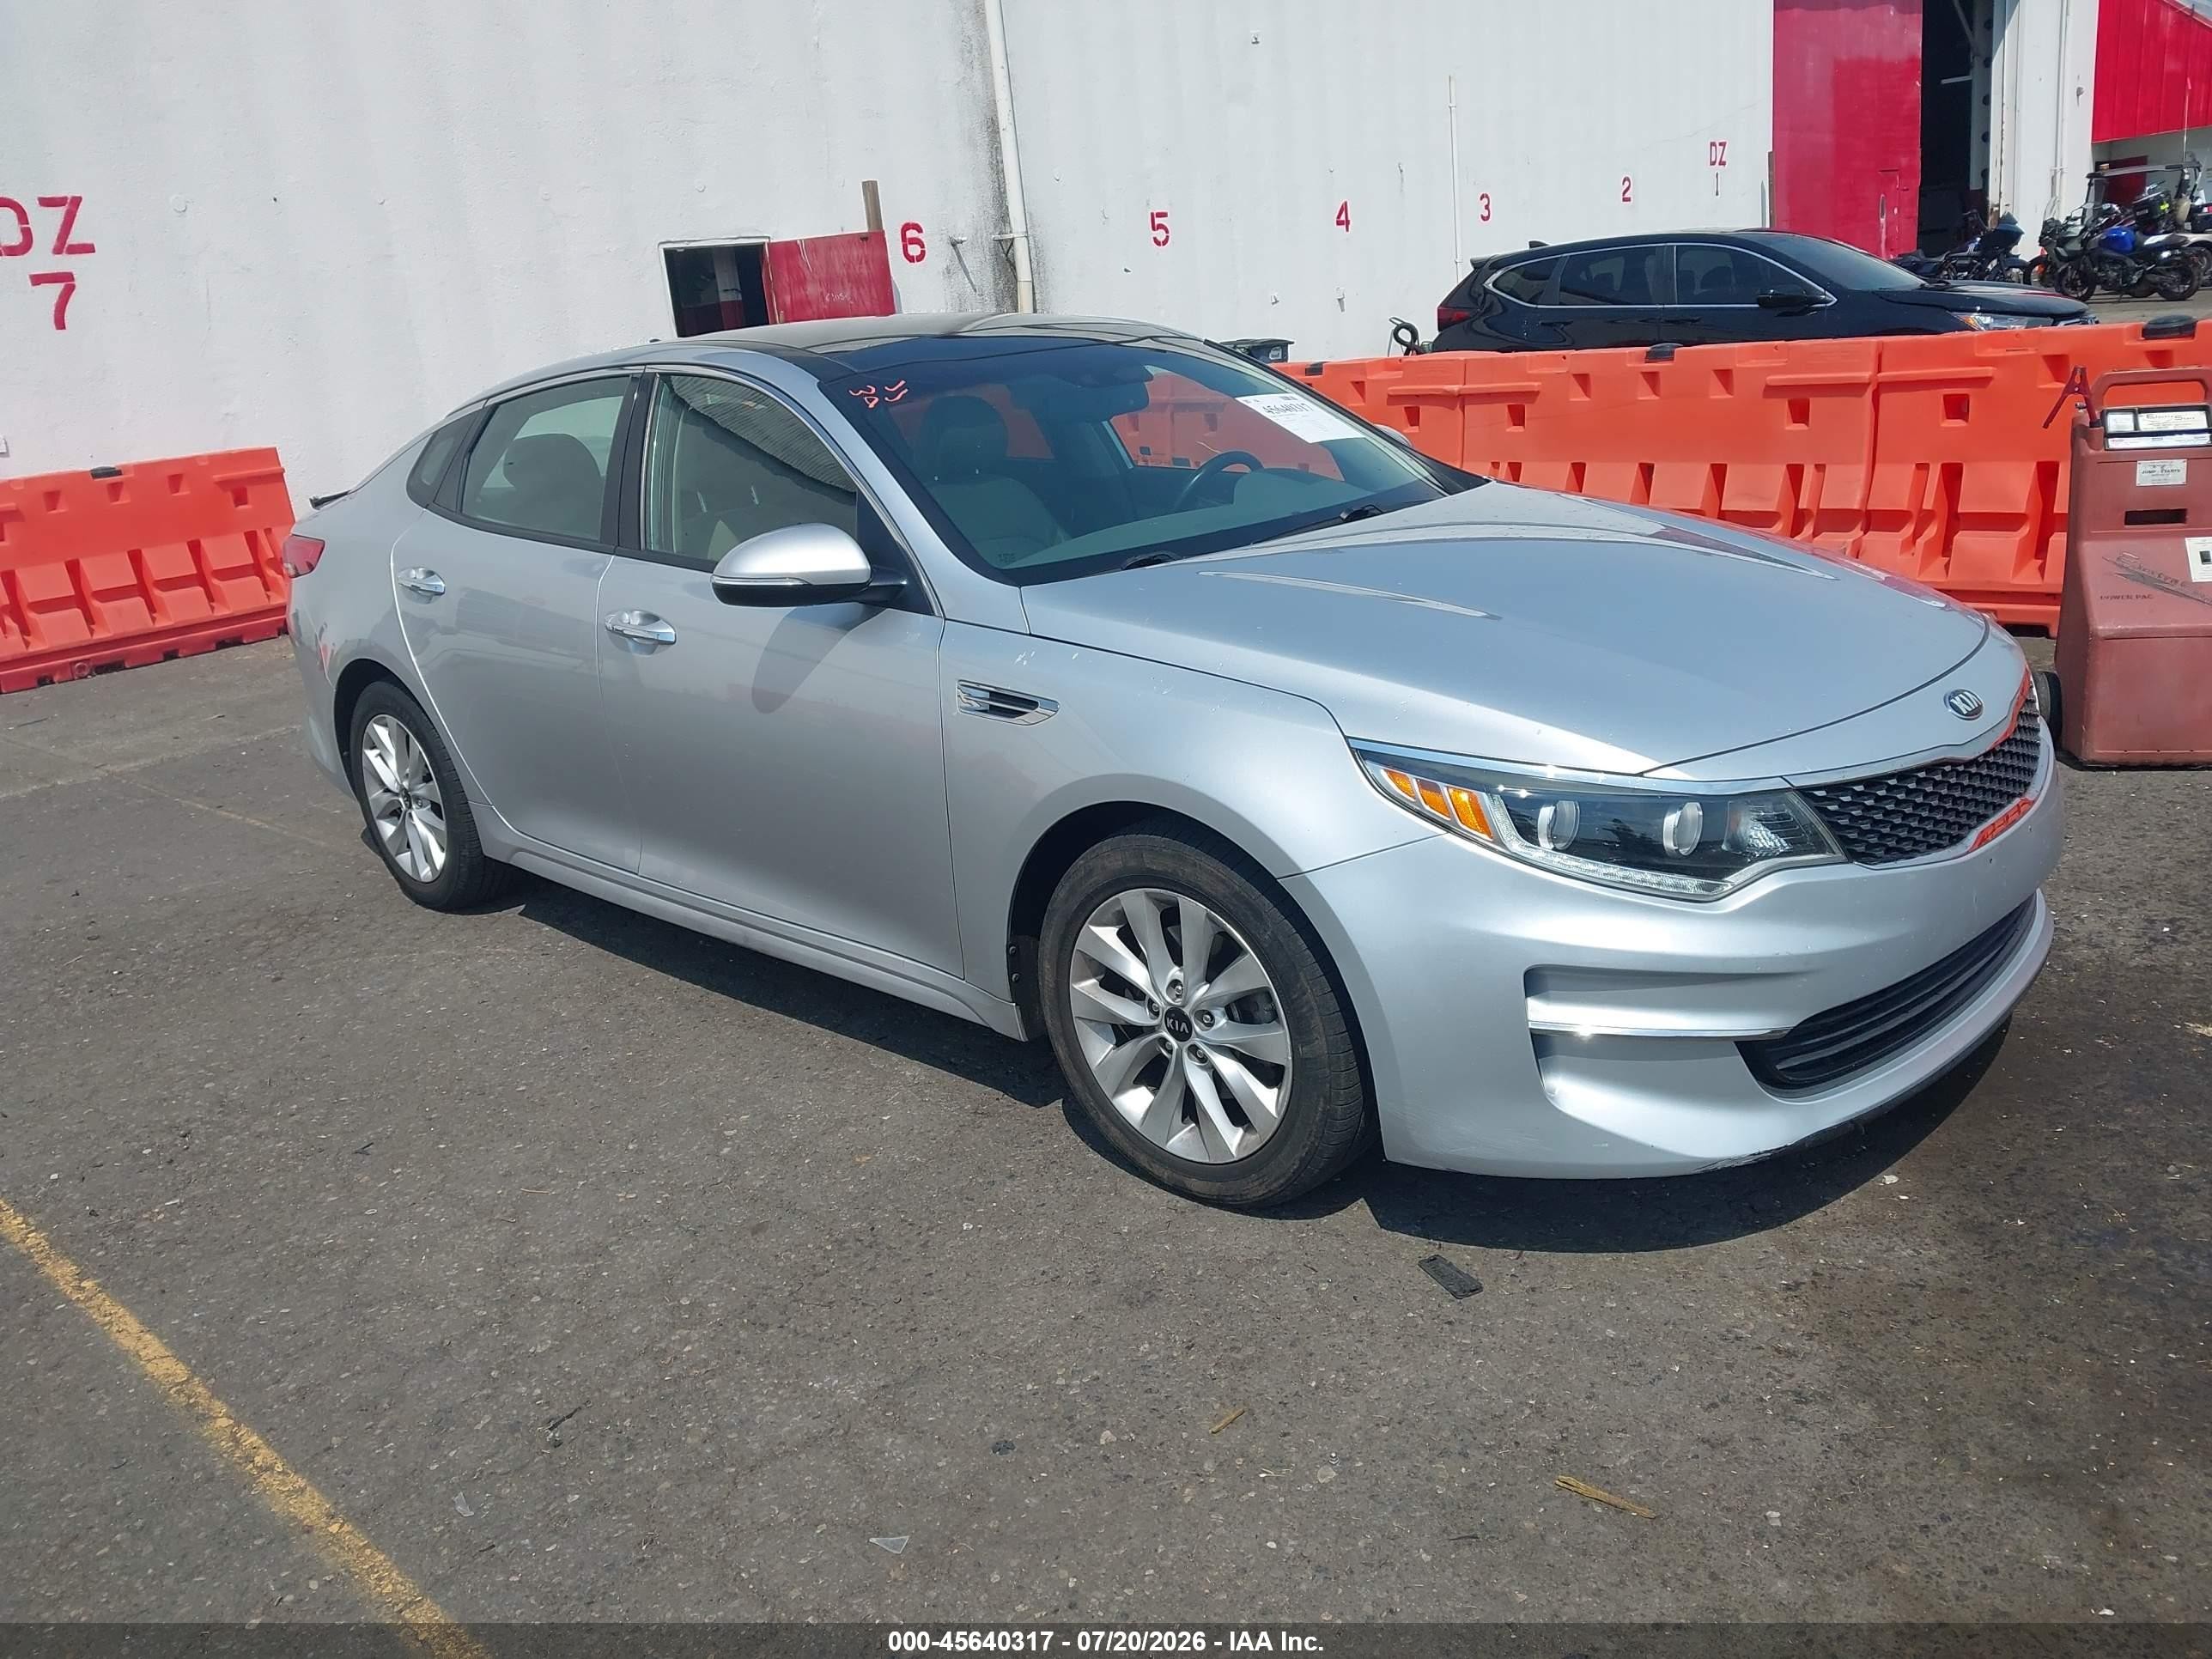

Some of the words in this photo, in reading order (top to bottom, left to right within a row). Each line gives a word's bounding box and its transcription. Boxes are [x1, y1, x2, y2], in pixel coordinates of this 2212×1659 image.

[1710, 141, 1727, 167] DZ
[1621, 176, 1632, 203] 2
[1335, 200, 1351, 233] 4
[1480, 192, 1491, 222] 3
[0, 196, 96, 257] DZ
[1151, 211, 1170, 247] 5
[900, 222, 927, 264] 6
[30, 271, 76, 331] 7
[1949, 690, 1982, 715] KIA
[1166, 1017, 1190, 1034] KIA
